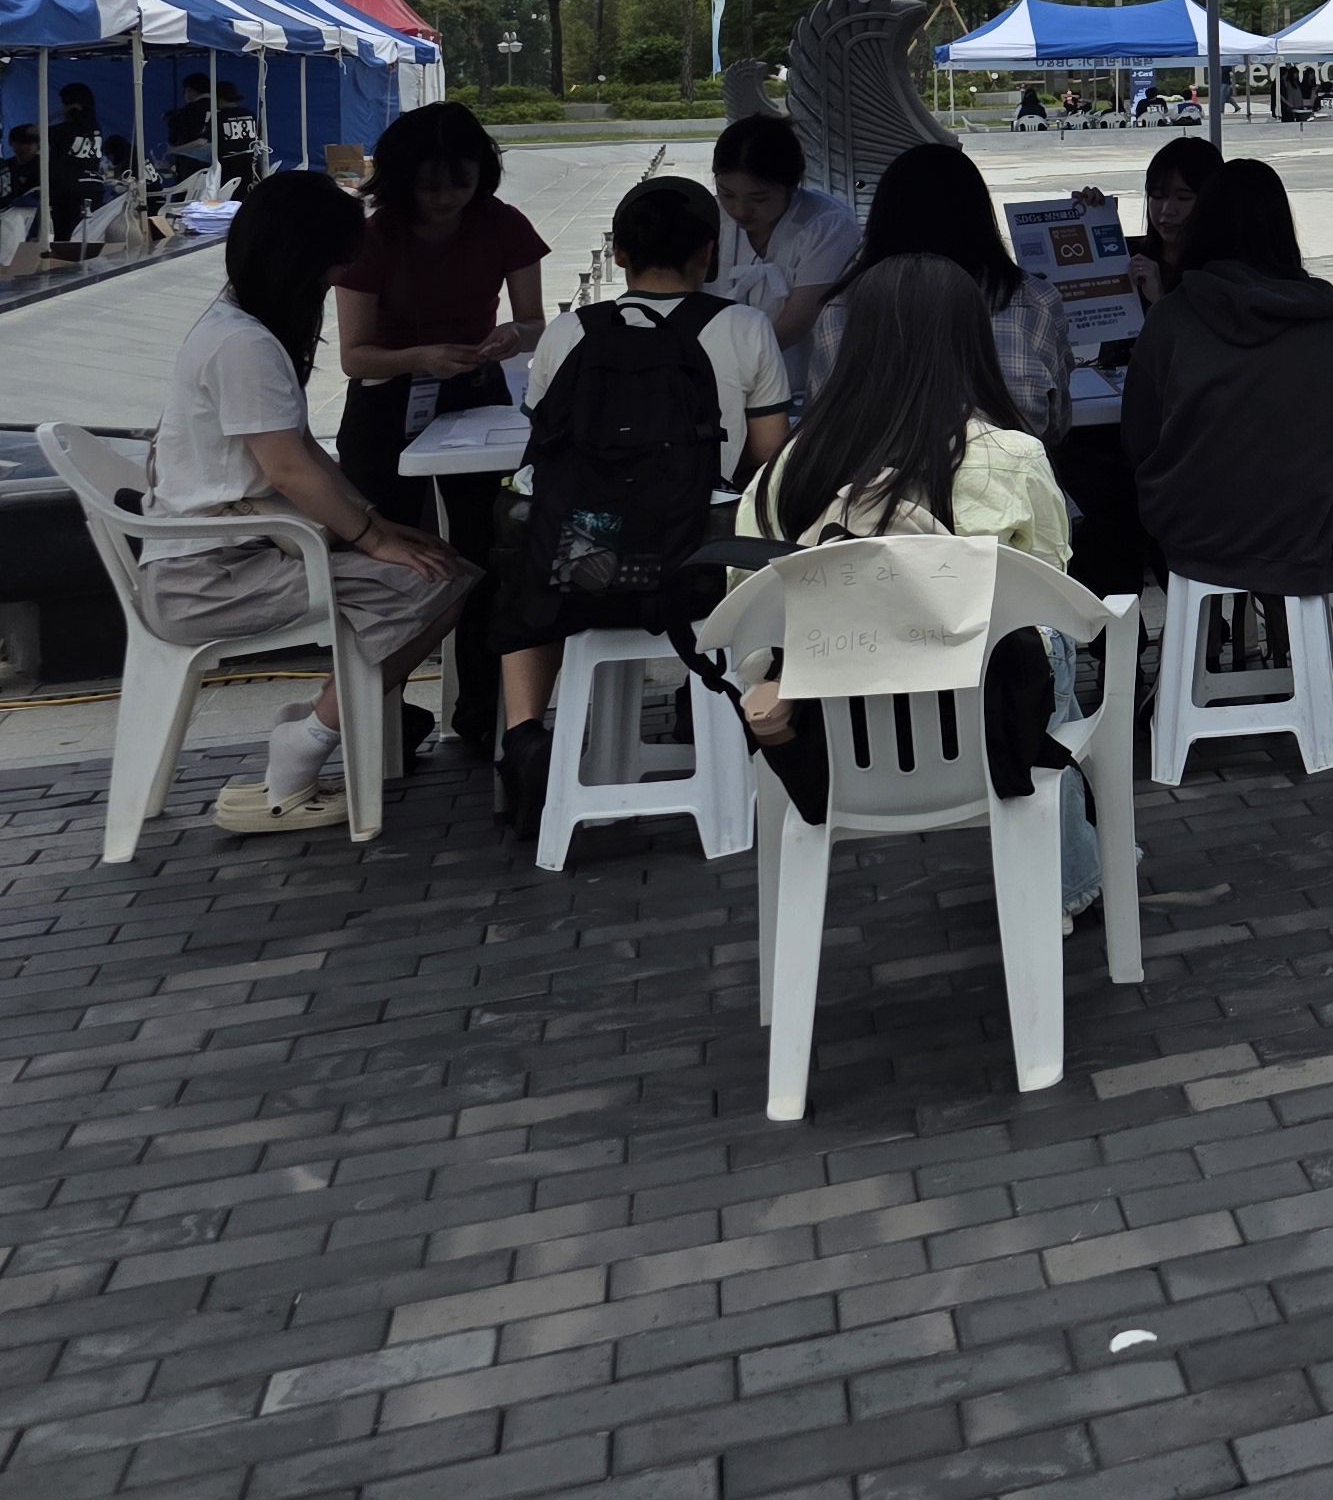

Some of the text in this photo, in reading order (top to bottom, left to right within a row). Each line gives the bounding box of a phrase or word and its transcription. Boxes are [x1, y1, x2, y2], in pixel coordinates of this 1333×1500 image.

[1014, 213, 1043, 226] SDGs
[805, 624, 954, 658] 웨이팅 의자
